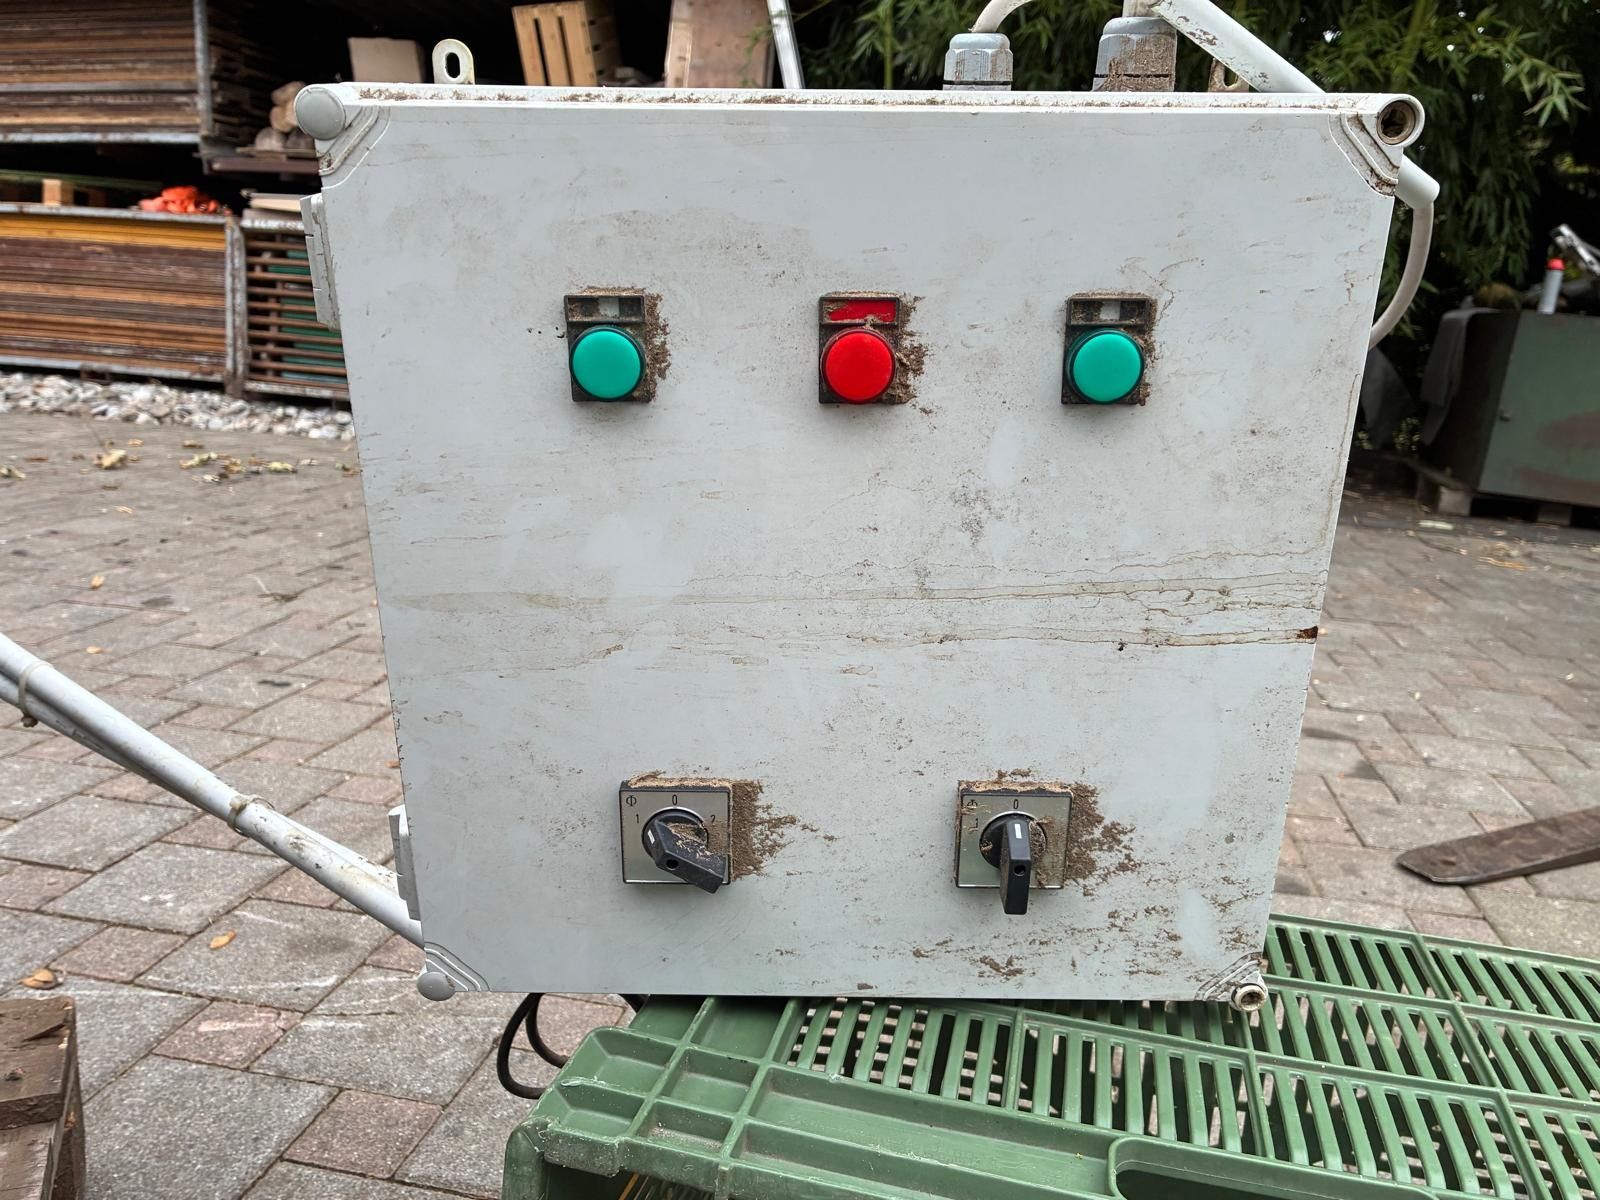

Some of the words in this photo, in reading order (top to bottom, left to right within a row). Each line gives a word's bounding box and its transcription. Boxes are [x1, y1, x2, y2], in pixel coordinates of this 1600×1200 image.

[671, 794, 678, 806] 0
[1013, 798, 1019, 810] 0
[635, 813, 640, 824] 1
